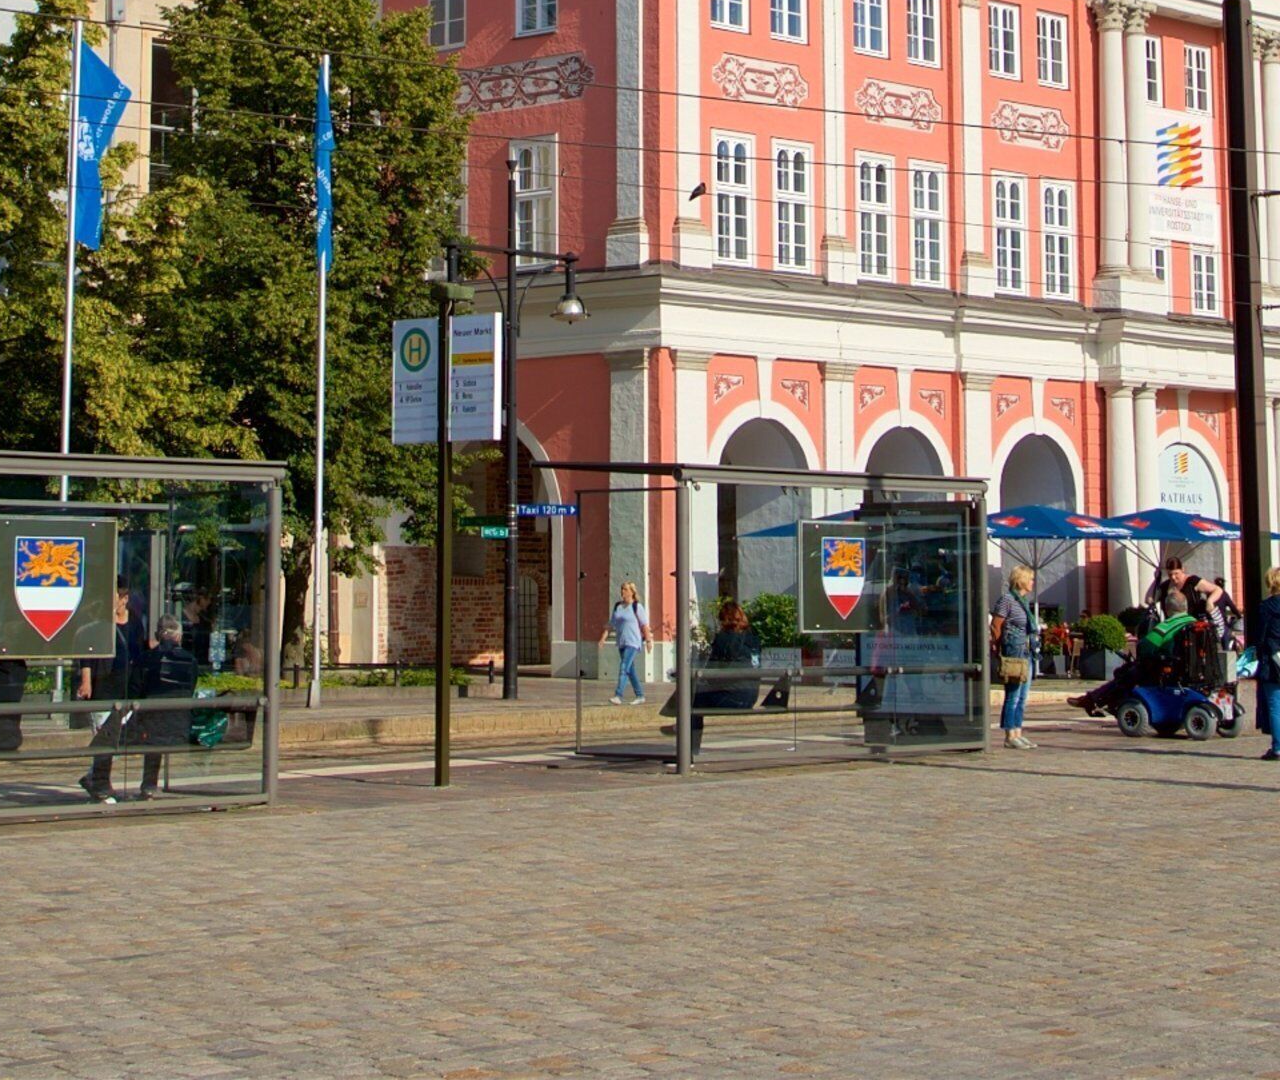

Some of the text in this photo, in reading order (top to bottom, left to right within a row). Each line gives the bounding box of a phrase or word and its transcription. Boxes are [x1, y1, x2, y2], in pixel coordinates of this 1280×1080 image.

[453, 327, 492, 337] Neuer Markt
[1160, 492, 1203, 504] RATHAUS
[521, 505, 540, 515] Taxi
[542, 505, 557, 515] 120
